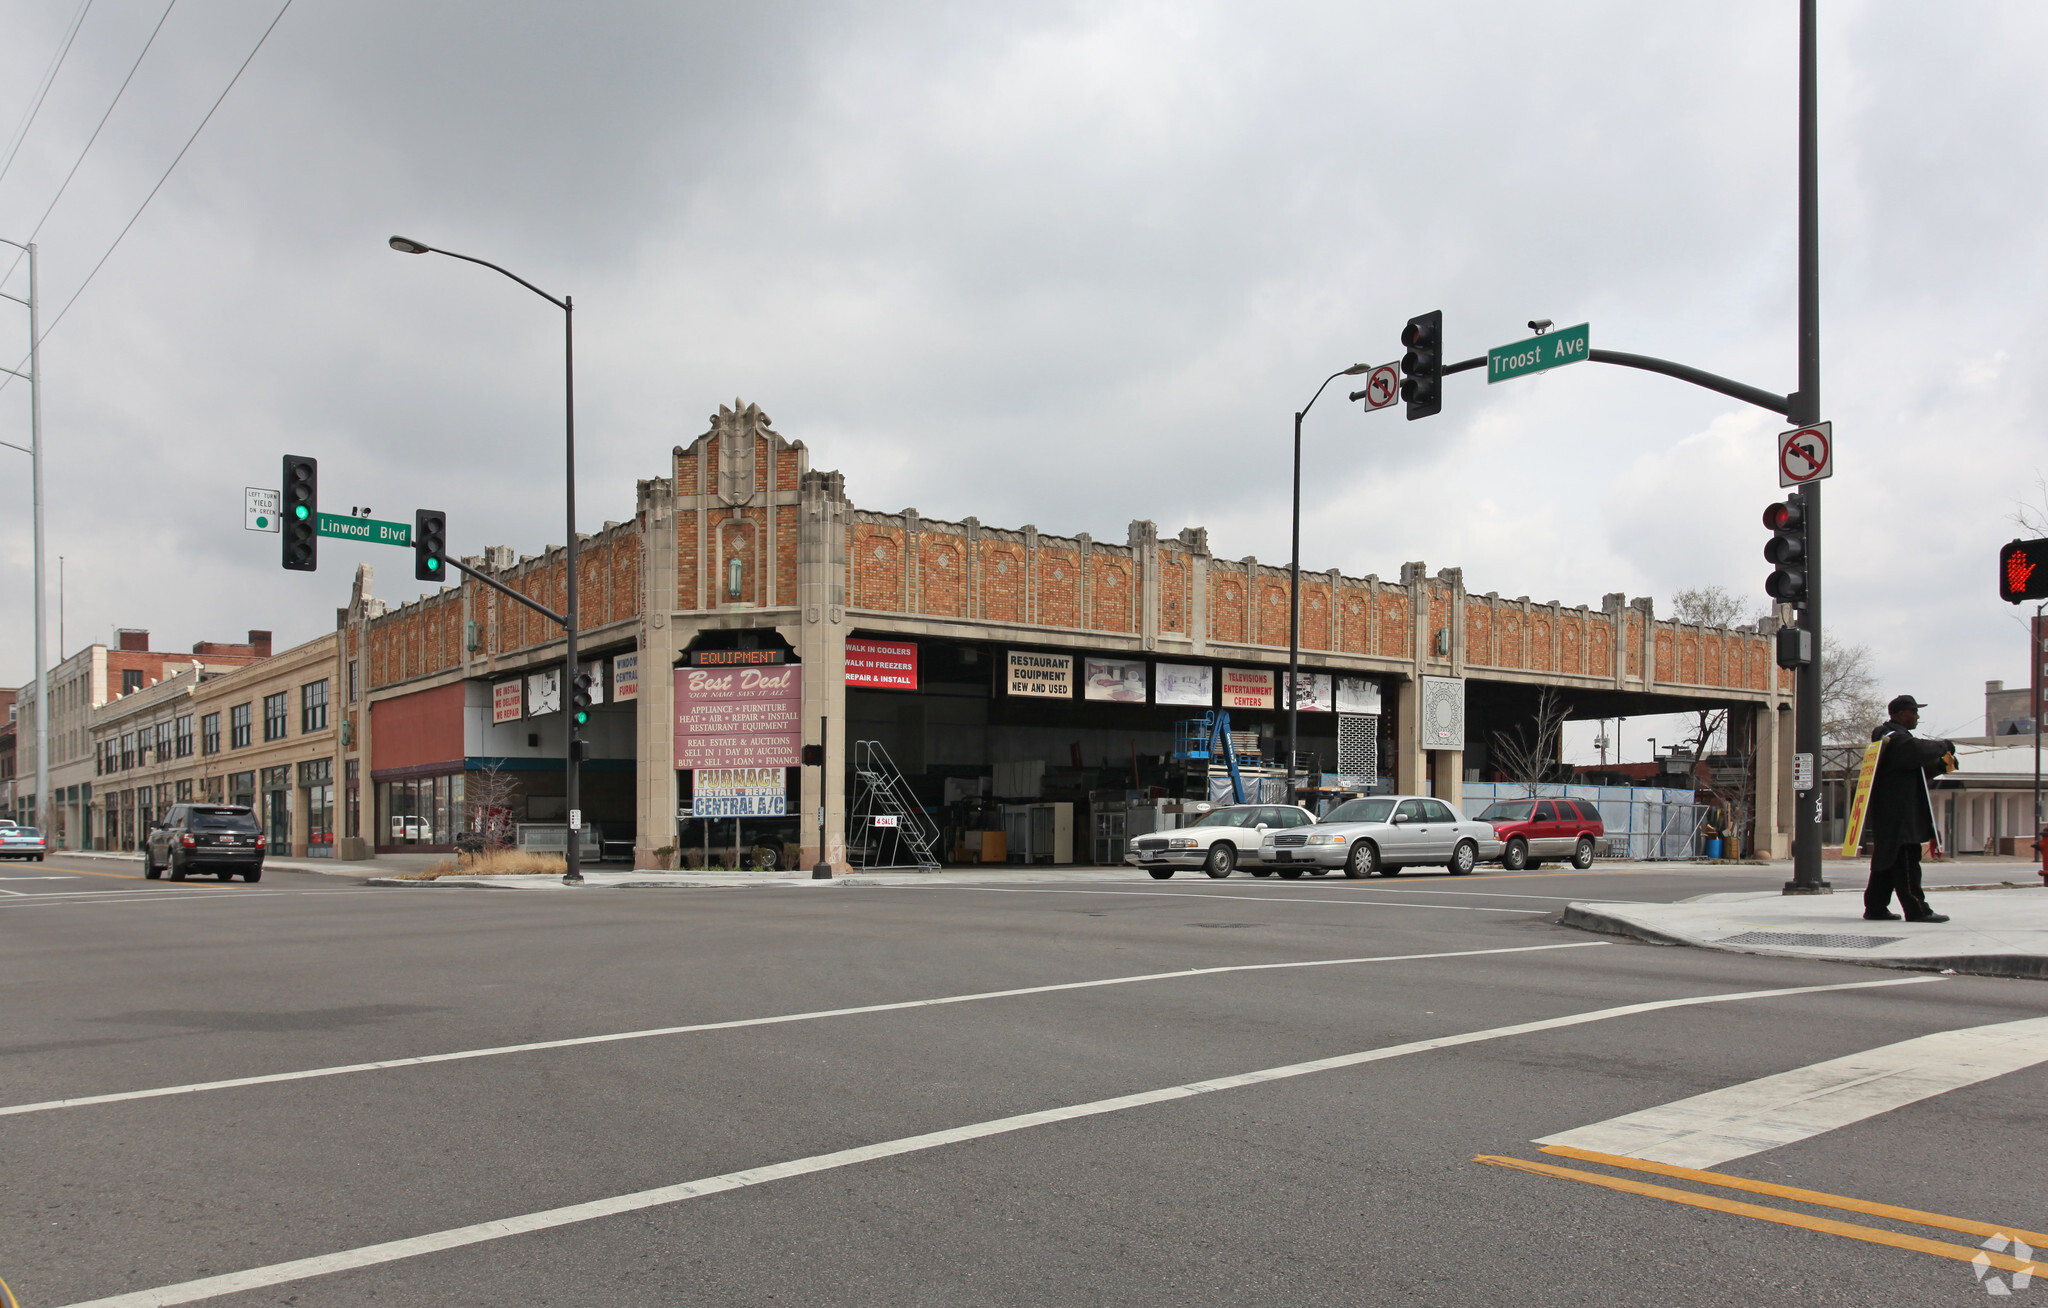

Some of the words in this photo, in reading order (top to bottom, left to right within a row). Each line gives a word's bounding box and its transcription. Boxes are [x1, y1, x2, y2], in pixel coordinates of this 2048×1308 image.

[1493, 345, 1541, 373] Troost
[1555, 337, 1584, 358] Ave
[253, 499, 273, 508] YIELD
[320, 518, 370, 537] Linwood
[380, 526, 406, 541] Blvd
[846, 644, 866, 652] WALK
[877, 646, 911, 656] COOLERS
[700, 650, 777, 665] EQUIPMENT
[1010, 655, 1070, 669] RESTAURANT
[845, 659, 864, 667] WALK
[875, 661, 912, 671] FREEZERS
[688, 670, 733, 691] Best
[740, 669, 791, 689] Deal
[845, 673, 872, 682] REPAIR
[880, 675, 911, 684] INSTALL
[1014, 669, 1066, 682] EQUIPMENT
[1228, 672, 1268, 684] TELEVISIONS
[496, 687, 502, 697] WE
[503, 684, 520, 696] INSTALL
[1012, 681, 1029, 692] NEW
[1031, 683, 1046, 693] AND
[1049, 684, 1068, 695] USED
[1223, 684, 1273, 696] ENTERTAINMENT
[496, 699, 502, 709] WE
[503, 695, 520, 707] DELIVER
[1234, 696, 1262, 707] CENTERS
[496, 710, 503, 720] WE
[504, 707, 520, 719] REPAIR
[691, 705, 733, 714] APPLIANCE
[742, 703, 787, 713] FURNITURE
[679, 715, 700, 723] HEAT
[732, 714, 758, 722] REPAIR
[768, 711, 799, 721] INSTALL
[690, 723, 739, 732] RESTAURANT
[742, 721, 788, 732] EQUIPMENT
[687, 739, 706, 747] REAL
[710, 738, 737, 746] ESTATE
[750, 737, 790, 745] AUCTIONS
[684, 749, 702, 757] SELL
[705, 748, 714, 756] IN
[725, 748, 741, 756] DAY
[744, 748, 754, 756] BY
[757, 746, 793, 755] AUCTION
[704, 758, 722, 766] SELL
[733, 757, 754, 766] LOAN
[766, 756, 800, 765] FINANCE
[698, 768, 781, 788] FURNACE
[695, 789, 738, 797] INSTALL
[744, 788, 785, 797] REPAIR
[695, 797, 755, 816] CENTRAL
[756, 796, 784, 815] A/C
[882, 817, 894, 825] SALE
